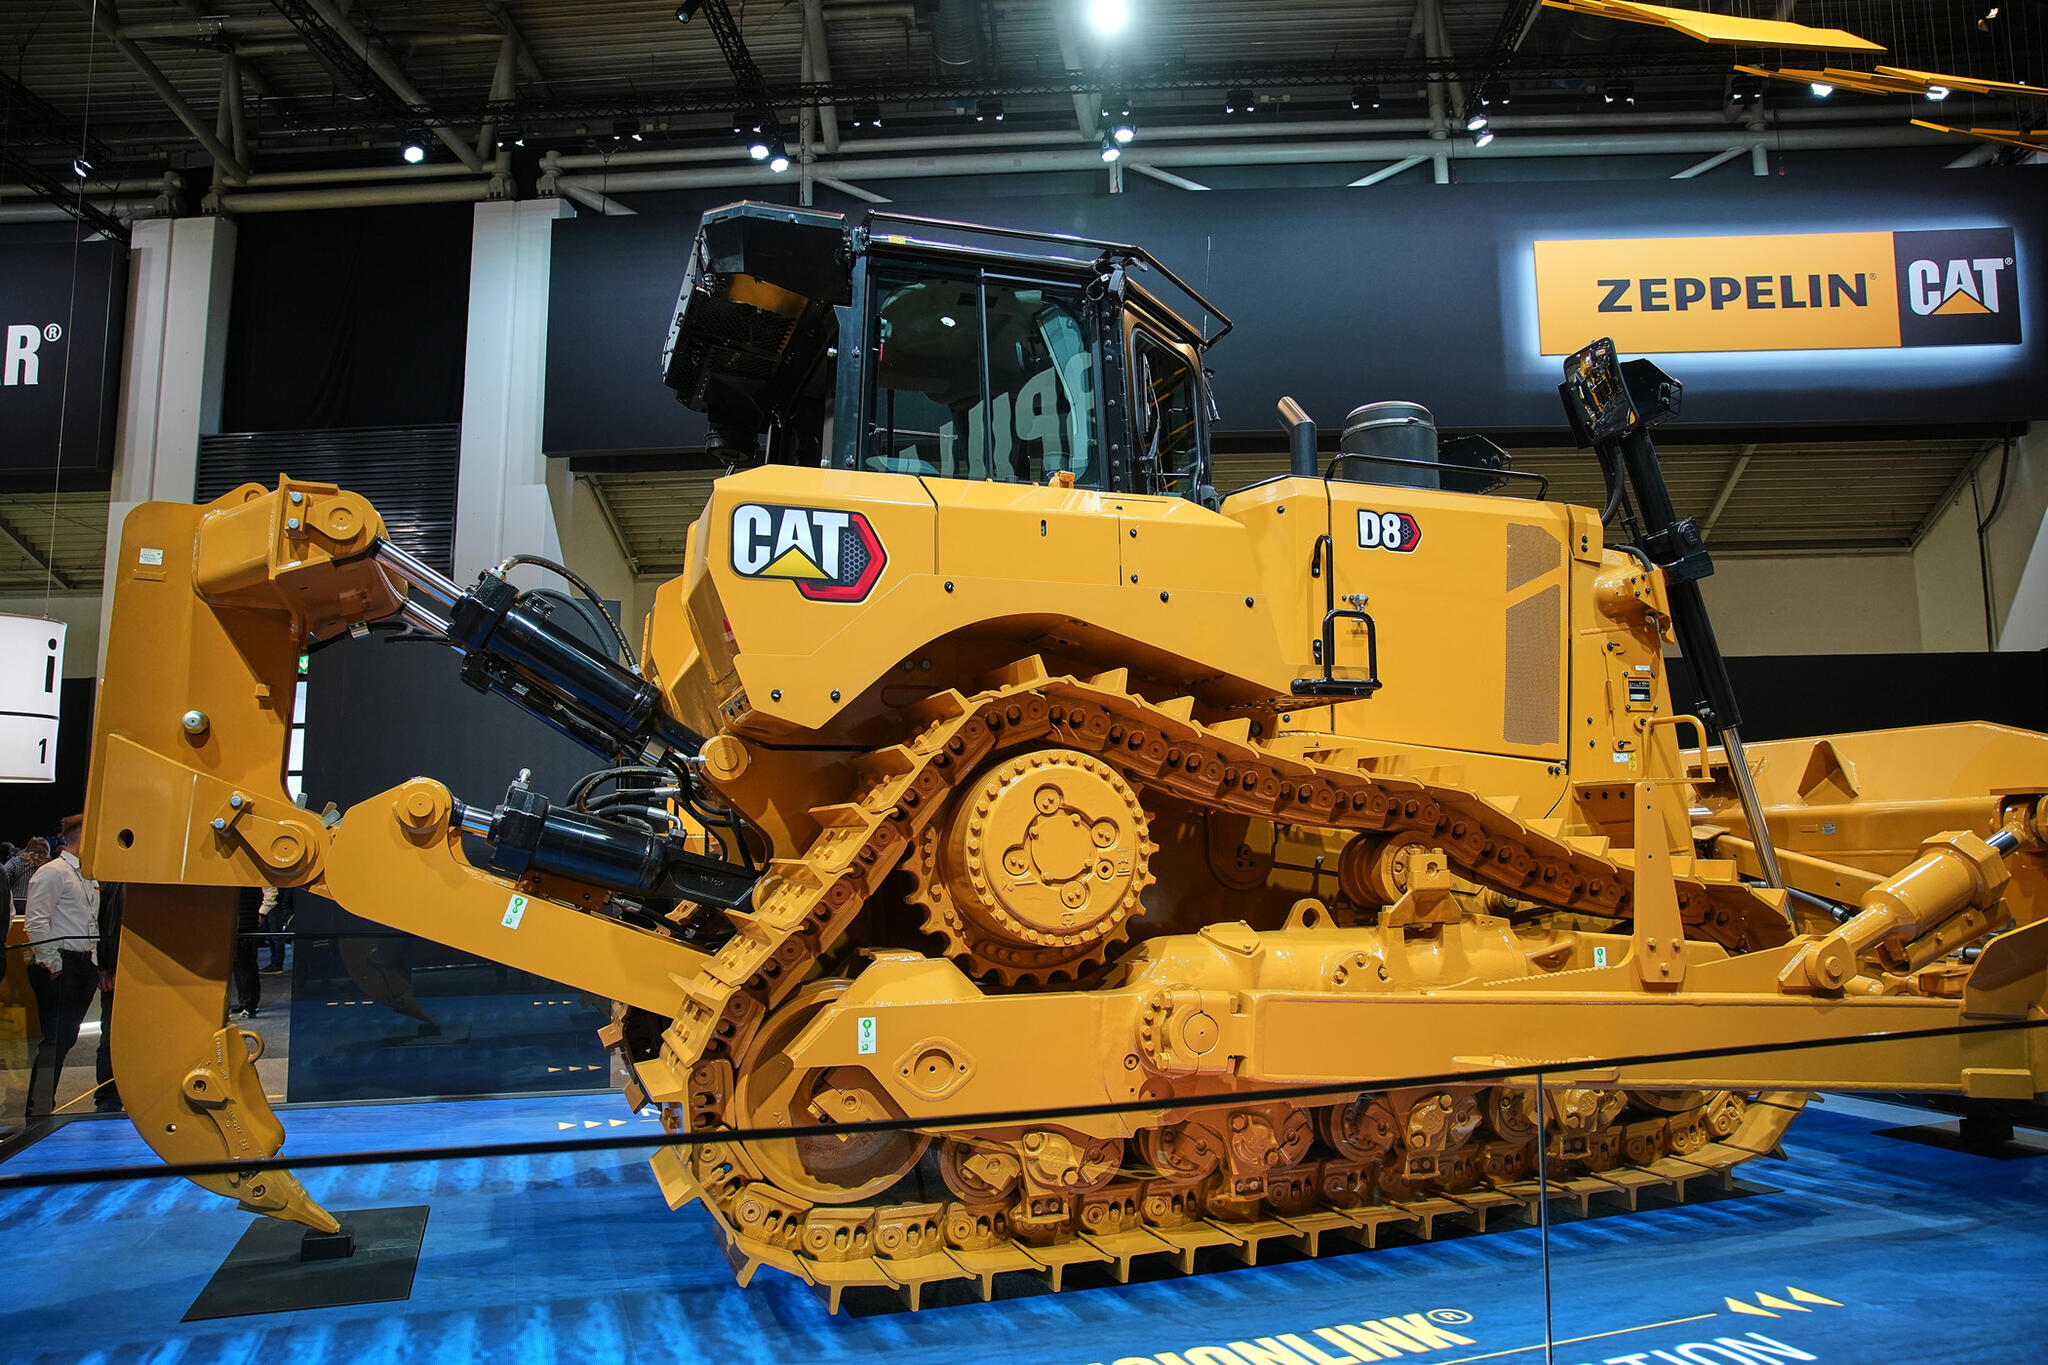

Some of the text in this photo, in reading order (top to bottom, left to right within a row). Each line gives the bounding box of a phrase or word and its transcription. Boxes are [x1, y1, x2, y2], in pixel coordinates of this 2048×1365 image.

[733, 505, 849, 580] CAT
[1359, 511, 1401, 548] D8
[38, 738, 47, 764] 1
